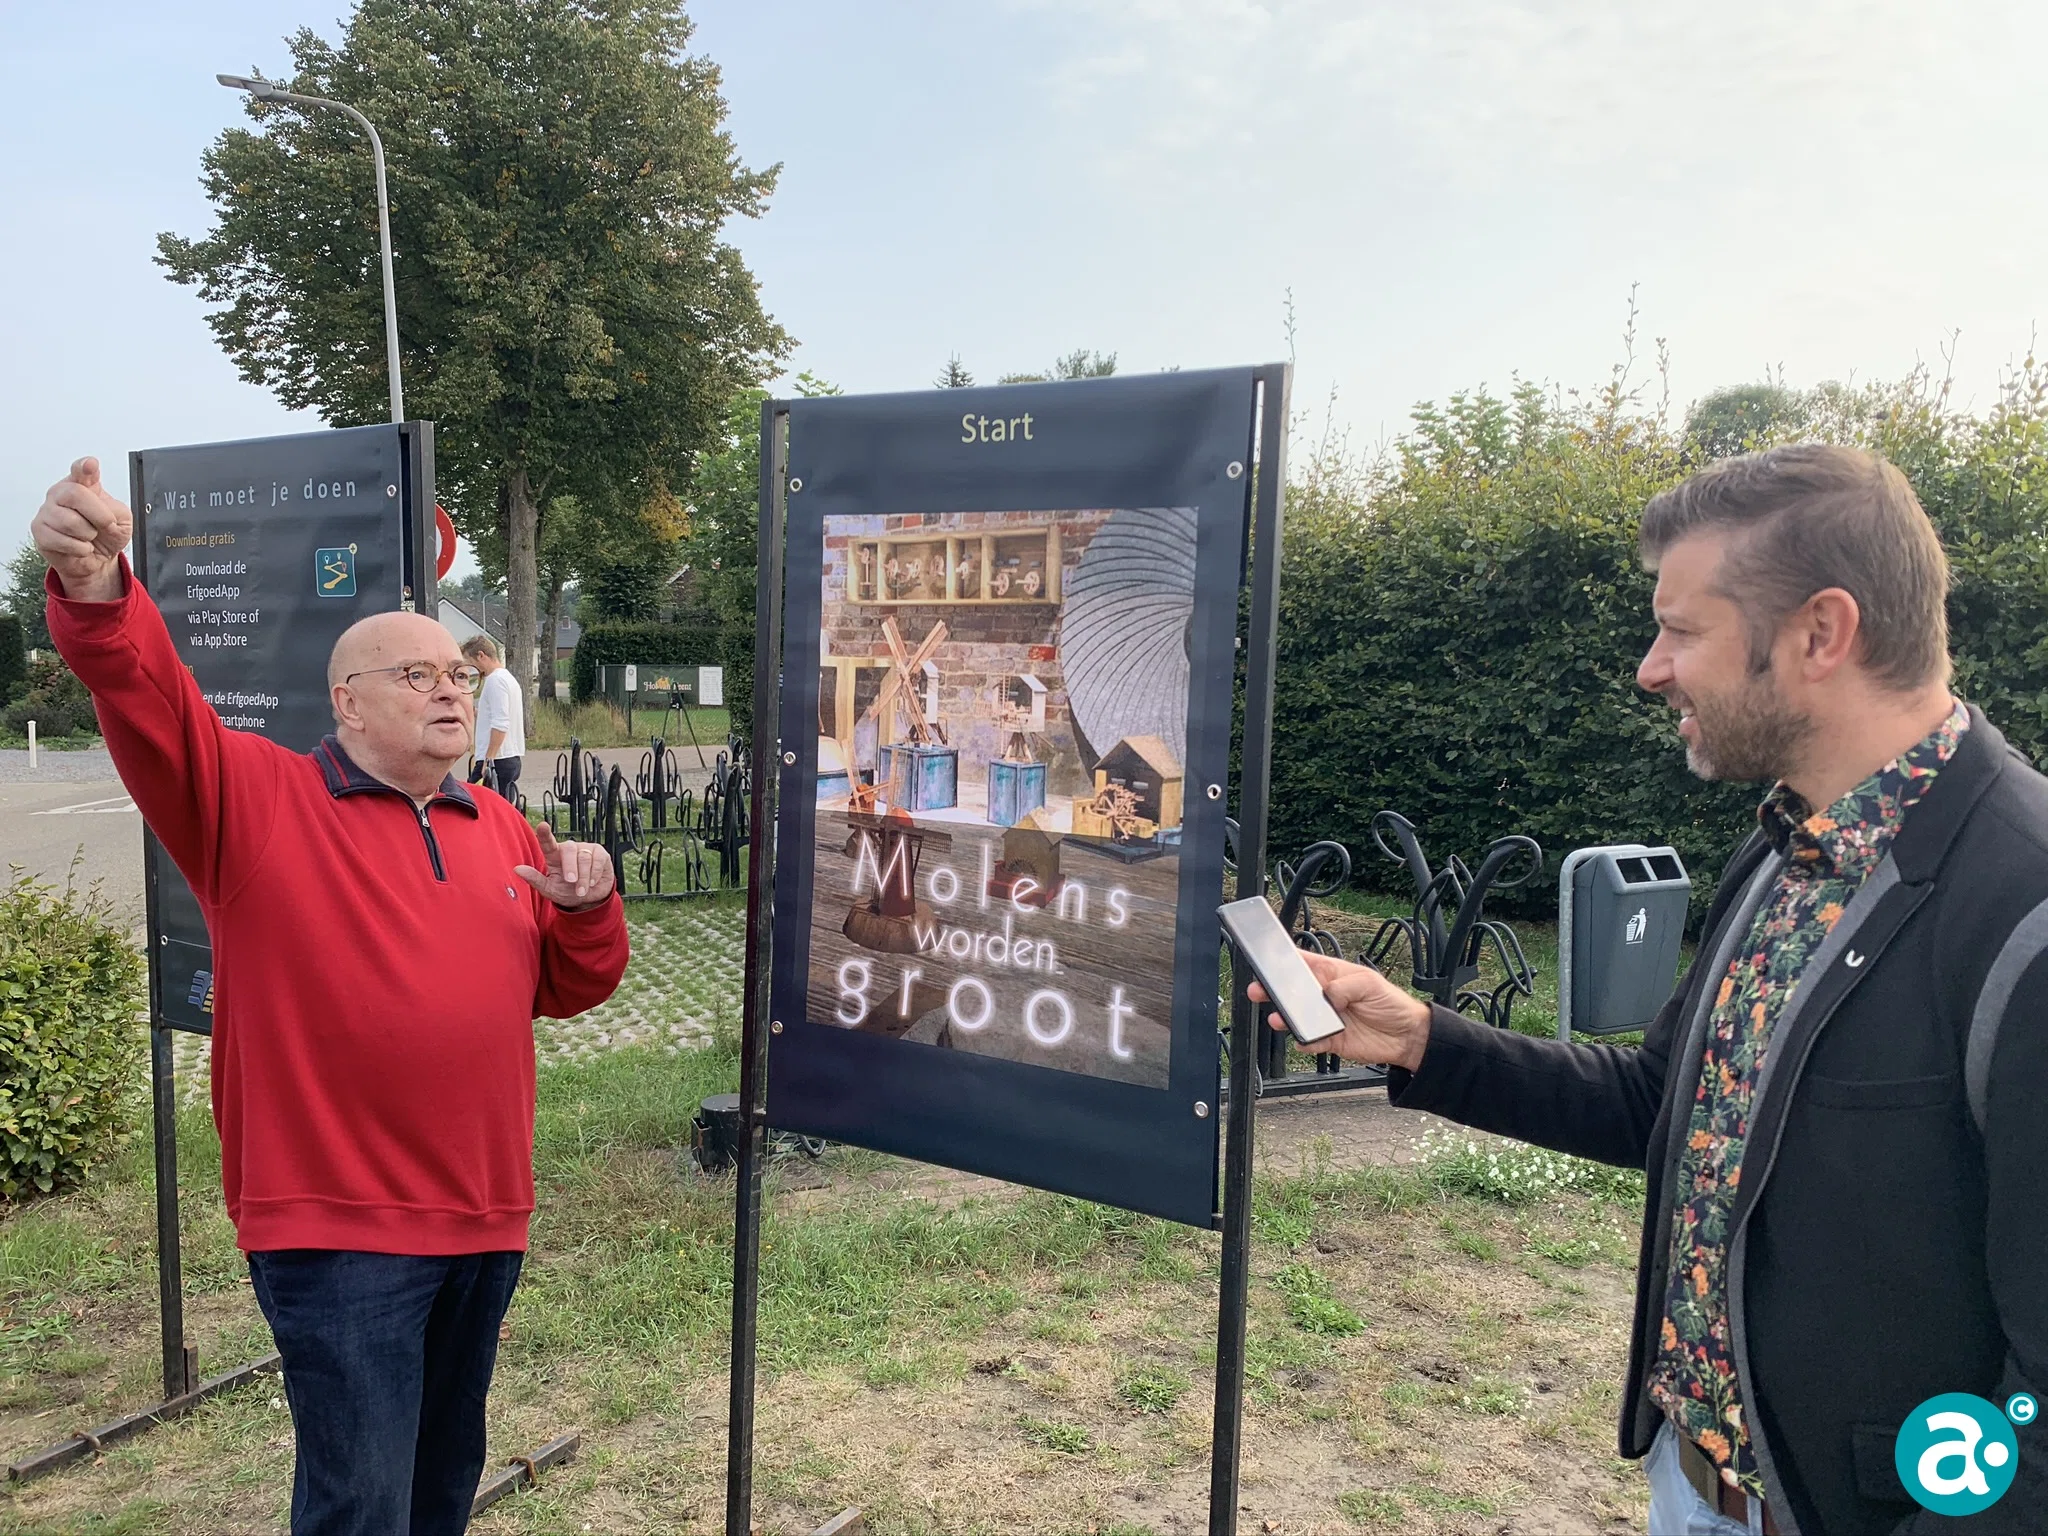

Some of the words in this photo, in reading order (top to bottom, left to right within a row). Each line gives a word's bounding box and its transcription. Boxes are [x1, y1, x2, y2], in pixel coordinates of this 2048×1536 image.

[961, 412, 1034, 444] Start
[164, 490, 196, 511] Wat
[209, 485, 255, 507] moet
[271, 481, 289, 507] je
[303, 477, 356, 500] doen
[165, 532, 208, 548] Download
[209, 531, 236, 548] gratis
[186, 560, 232, 577] Download
[234, 560, 247, 574] de
[187, 583, 240, 601] ErfgoedApp
[187, 610, 201, 624] via
[202, 609, 220, 627] Play
[222, 610, 247, 624] Store
[248, 608, 260, 623] of
[190, 632, 203, 646] via
[204, 632, 222, 650] App
[222, 632, 248, 647] Store
[214, 691, 226, 705] de
[227, 691, 279, 709] ErfgoedApp
[218, 713, 266, 730] martphone
[854, 831, 1131, 926] Molens
[913, 915, 1055, 970] worden
[836, 960, 1134, 1058] groot
